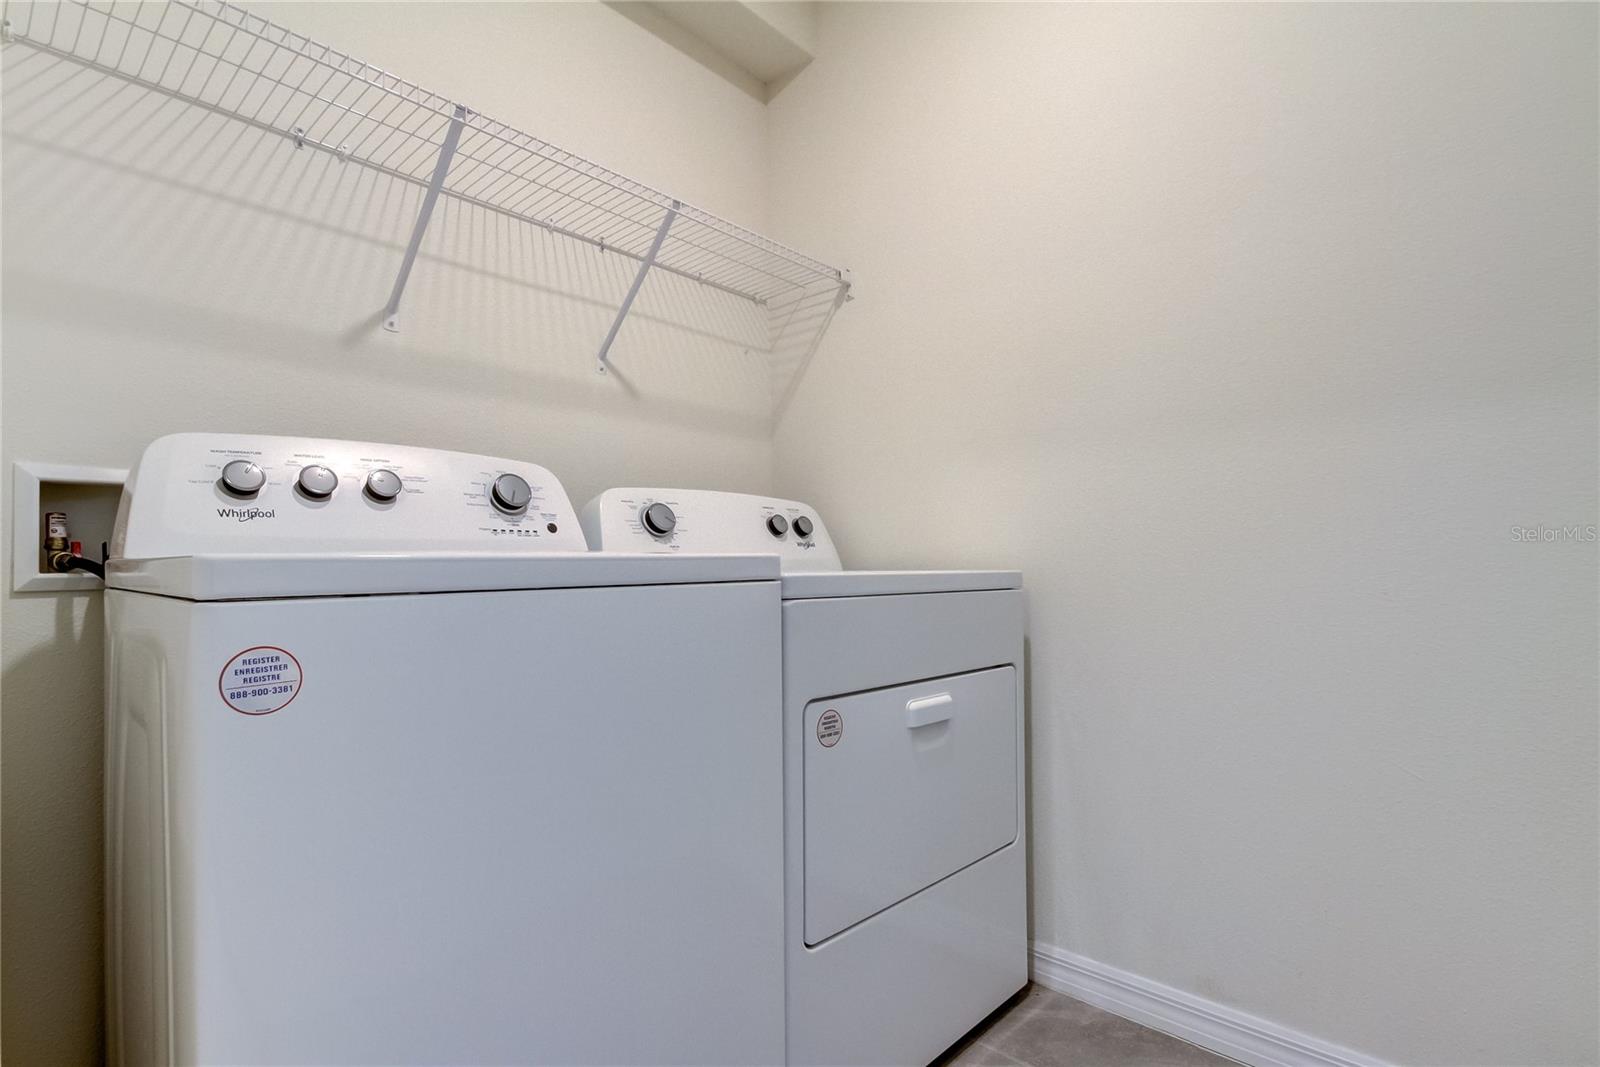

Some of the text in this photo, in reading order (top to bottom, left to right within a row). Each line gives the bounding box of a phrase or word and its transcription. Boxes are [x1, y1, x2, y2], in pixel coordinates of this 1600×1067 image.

[216, 508, 275, 521] Whirlpool
[242, 656, 280, 666] REGISTER
[234, 664, 288, 676] ENREGISTRER
[243, 674, 280, 684] REGISTRE
[230, 685, 293, 700] 888-900-3381
